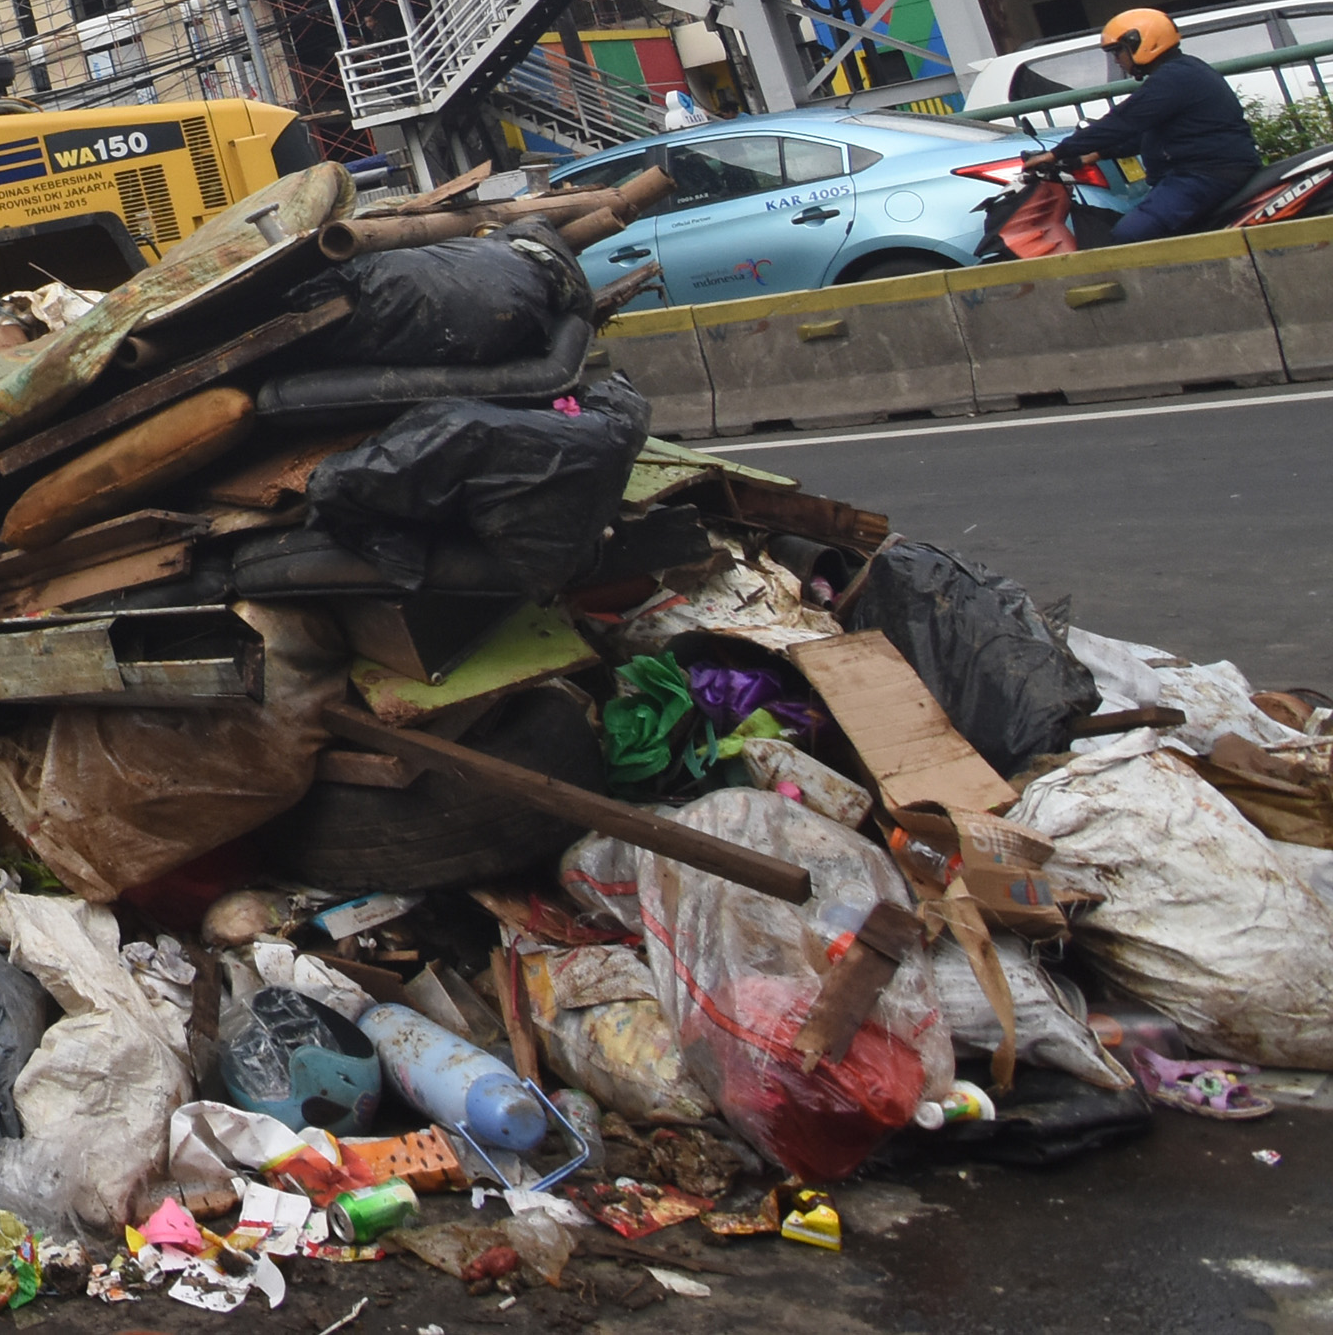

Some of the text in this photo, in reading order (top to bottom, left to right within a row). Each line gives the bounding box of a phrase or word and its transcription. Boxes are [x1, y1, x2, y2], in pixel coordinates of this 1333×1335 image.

[54, 132, 148, 169] WA150
[33, 171, 103, 193] KEBERSIHAN
[43, 191, 63, 202] DKI
[65, 180, 116, 199] JAKARTA
[24, 197, 88, 218] TAHUN 2015
[765, 184, 851, 212] KAR 4005
[693, 274, 746, 289] indonesia
